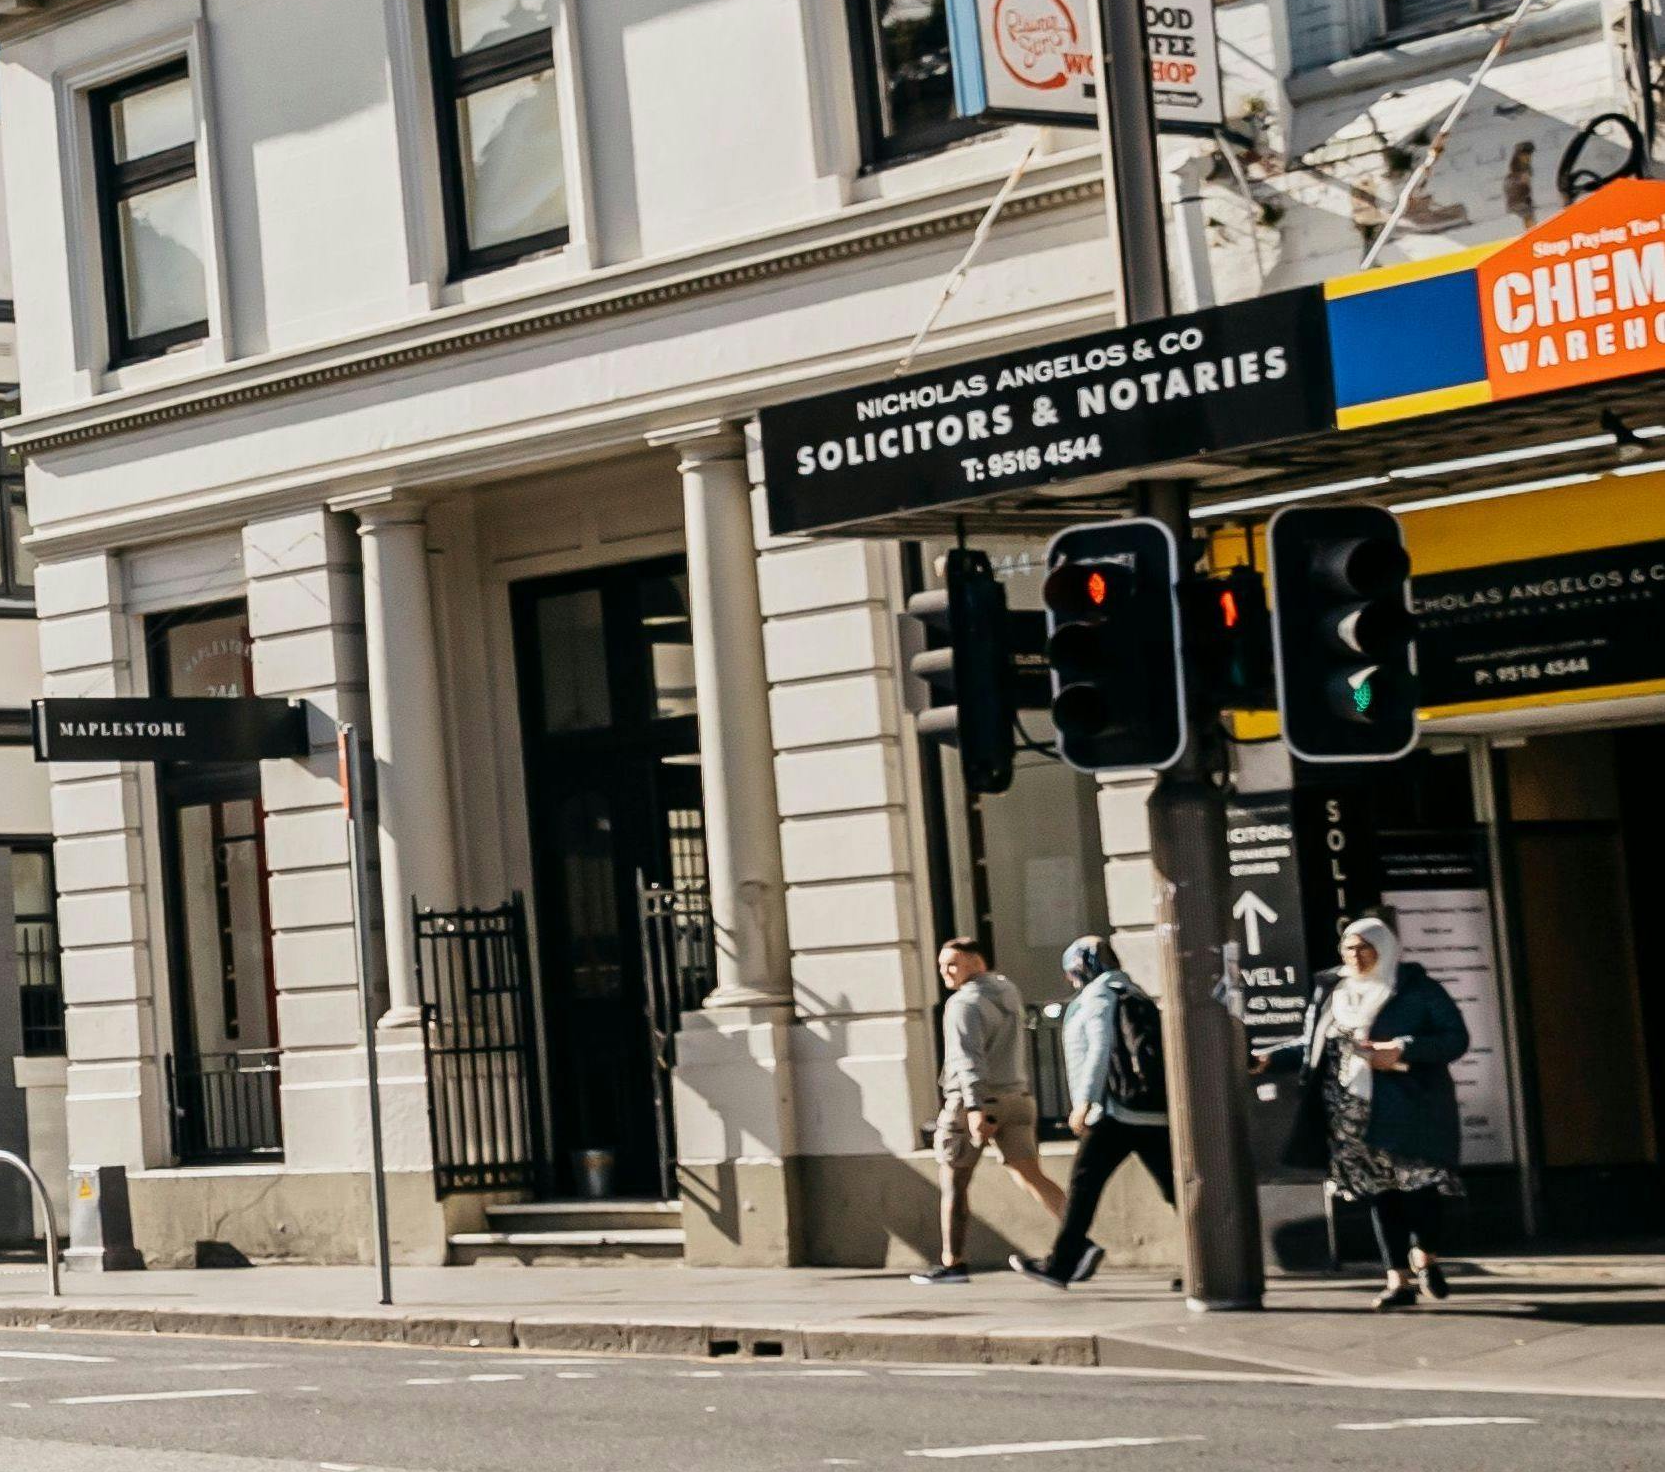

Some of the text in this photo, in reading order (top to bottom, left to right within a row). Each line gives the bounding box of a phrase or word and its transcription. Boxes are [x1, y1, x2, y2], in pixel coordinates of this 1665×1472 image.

[1146, 5, 1193, 29] OOD
[857, 328, 1203, 421] NICHOLAS ANGELOS & CO
[796, 346, 1289, 476] SOLICITORS & NOTARIES
[961, 458, 985, 482] T:
[987, 444, 1041, 477] 9516
[1510, 569, 1623, 599] ANGELOS
[59, 722, 186, 737] MAPLESTORE
